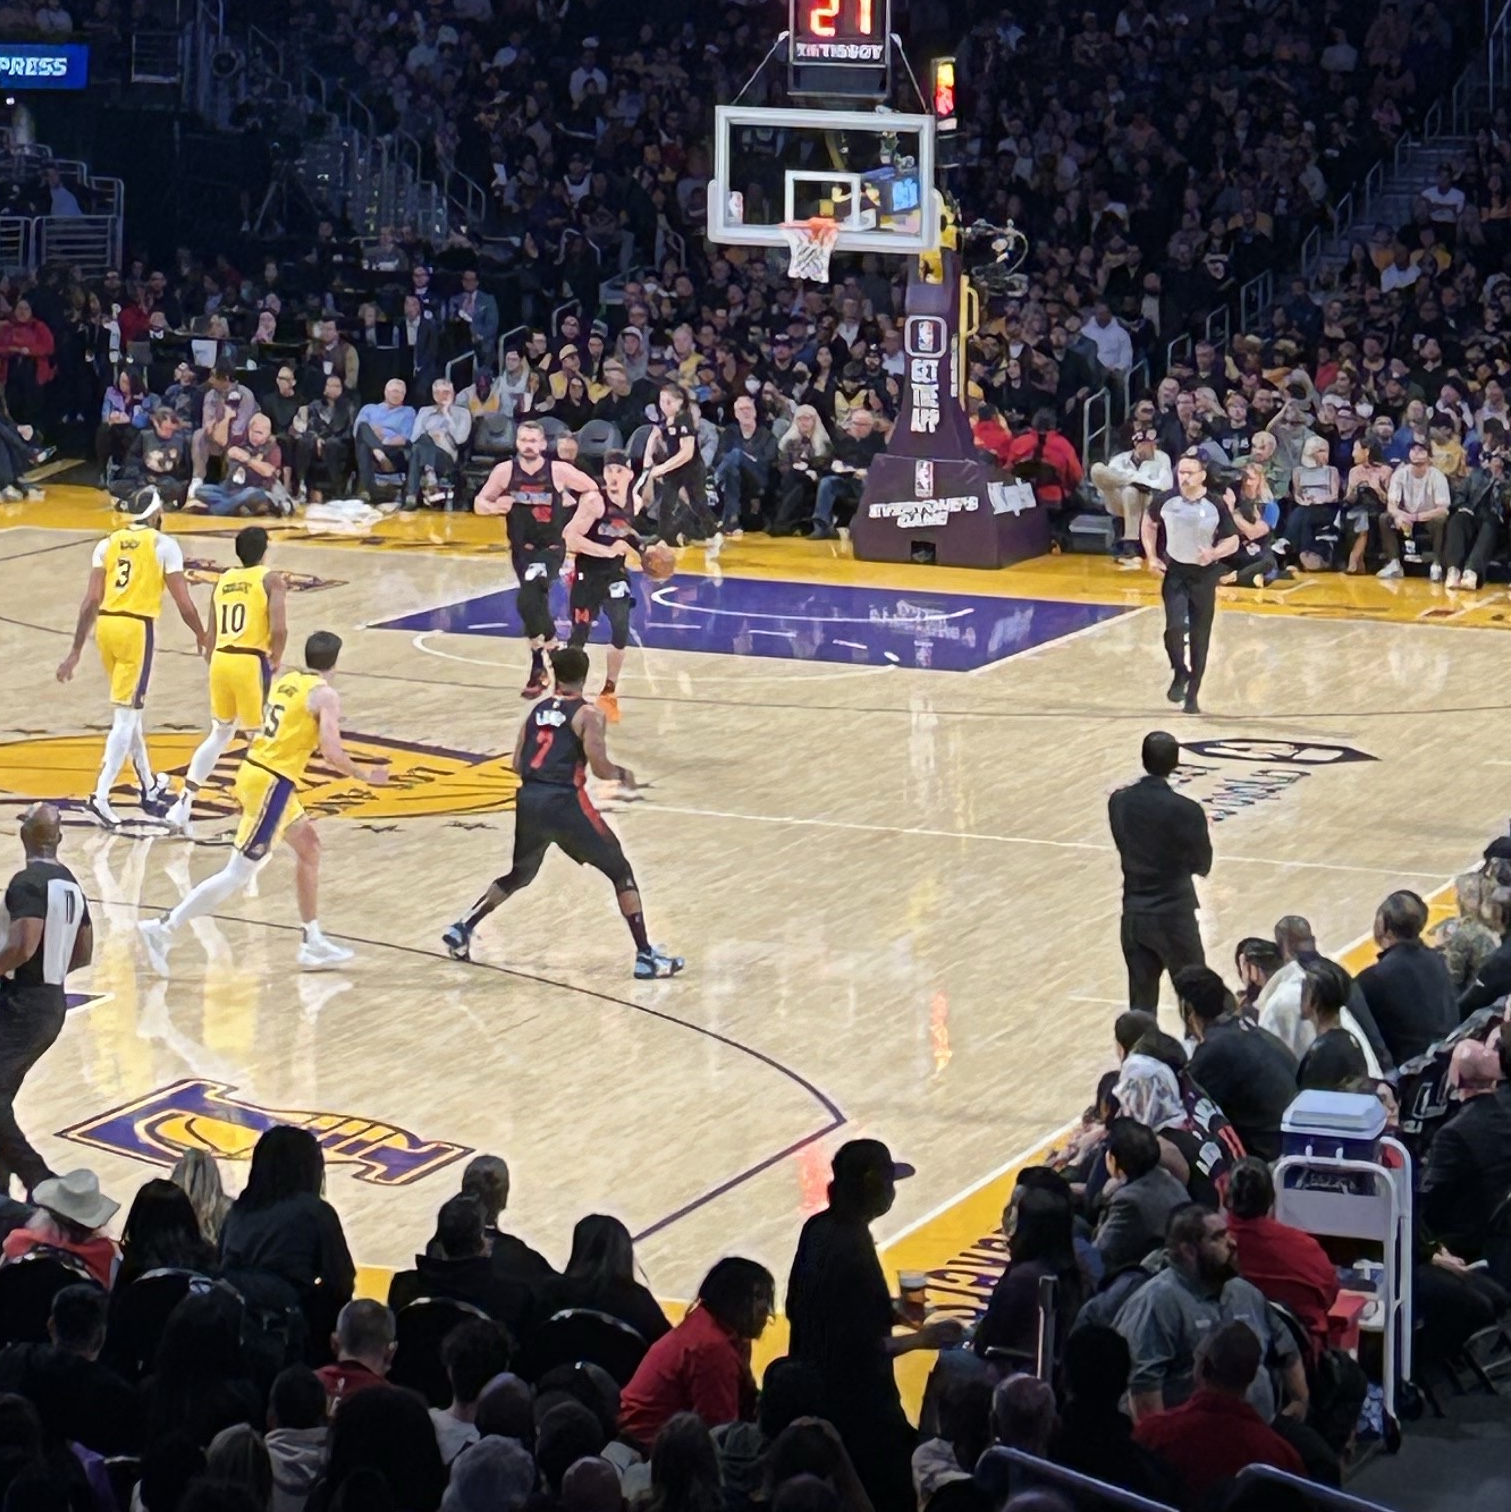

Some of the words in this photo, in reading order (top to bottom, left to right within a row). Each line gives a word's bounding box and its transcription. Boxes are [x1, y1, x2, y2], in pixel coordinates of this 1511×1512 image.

[114, 558, 131, 589] 3
[221, 602, 246, 635] 10
[529, 729, 554, 769] 7
